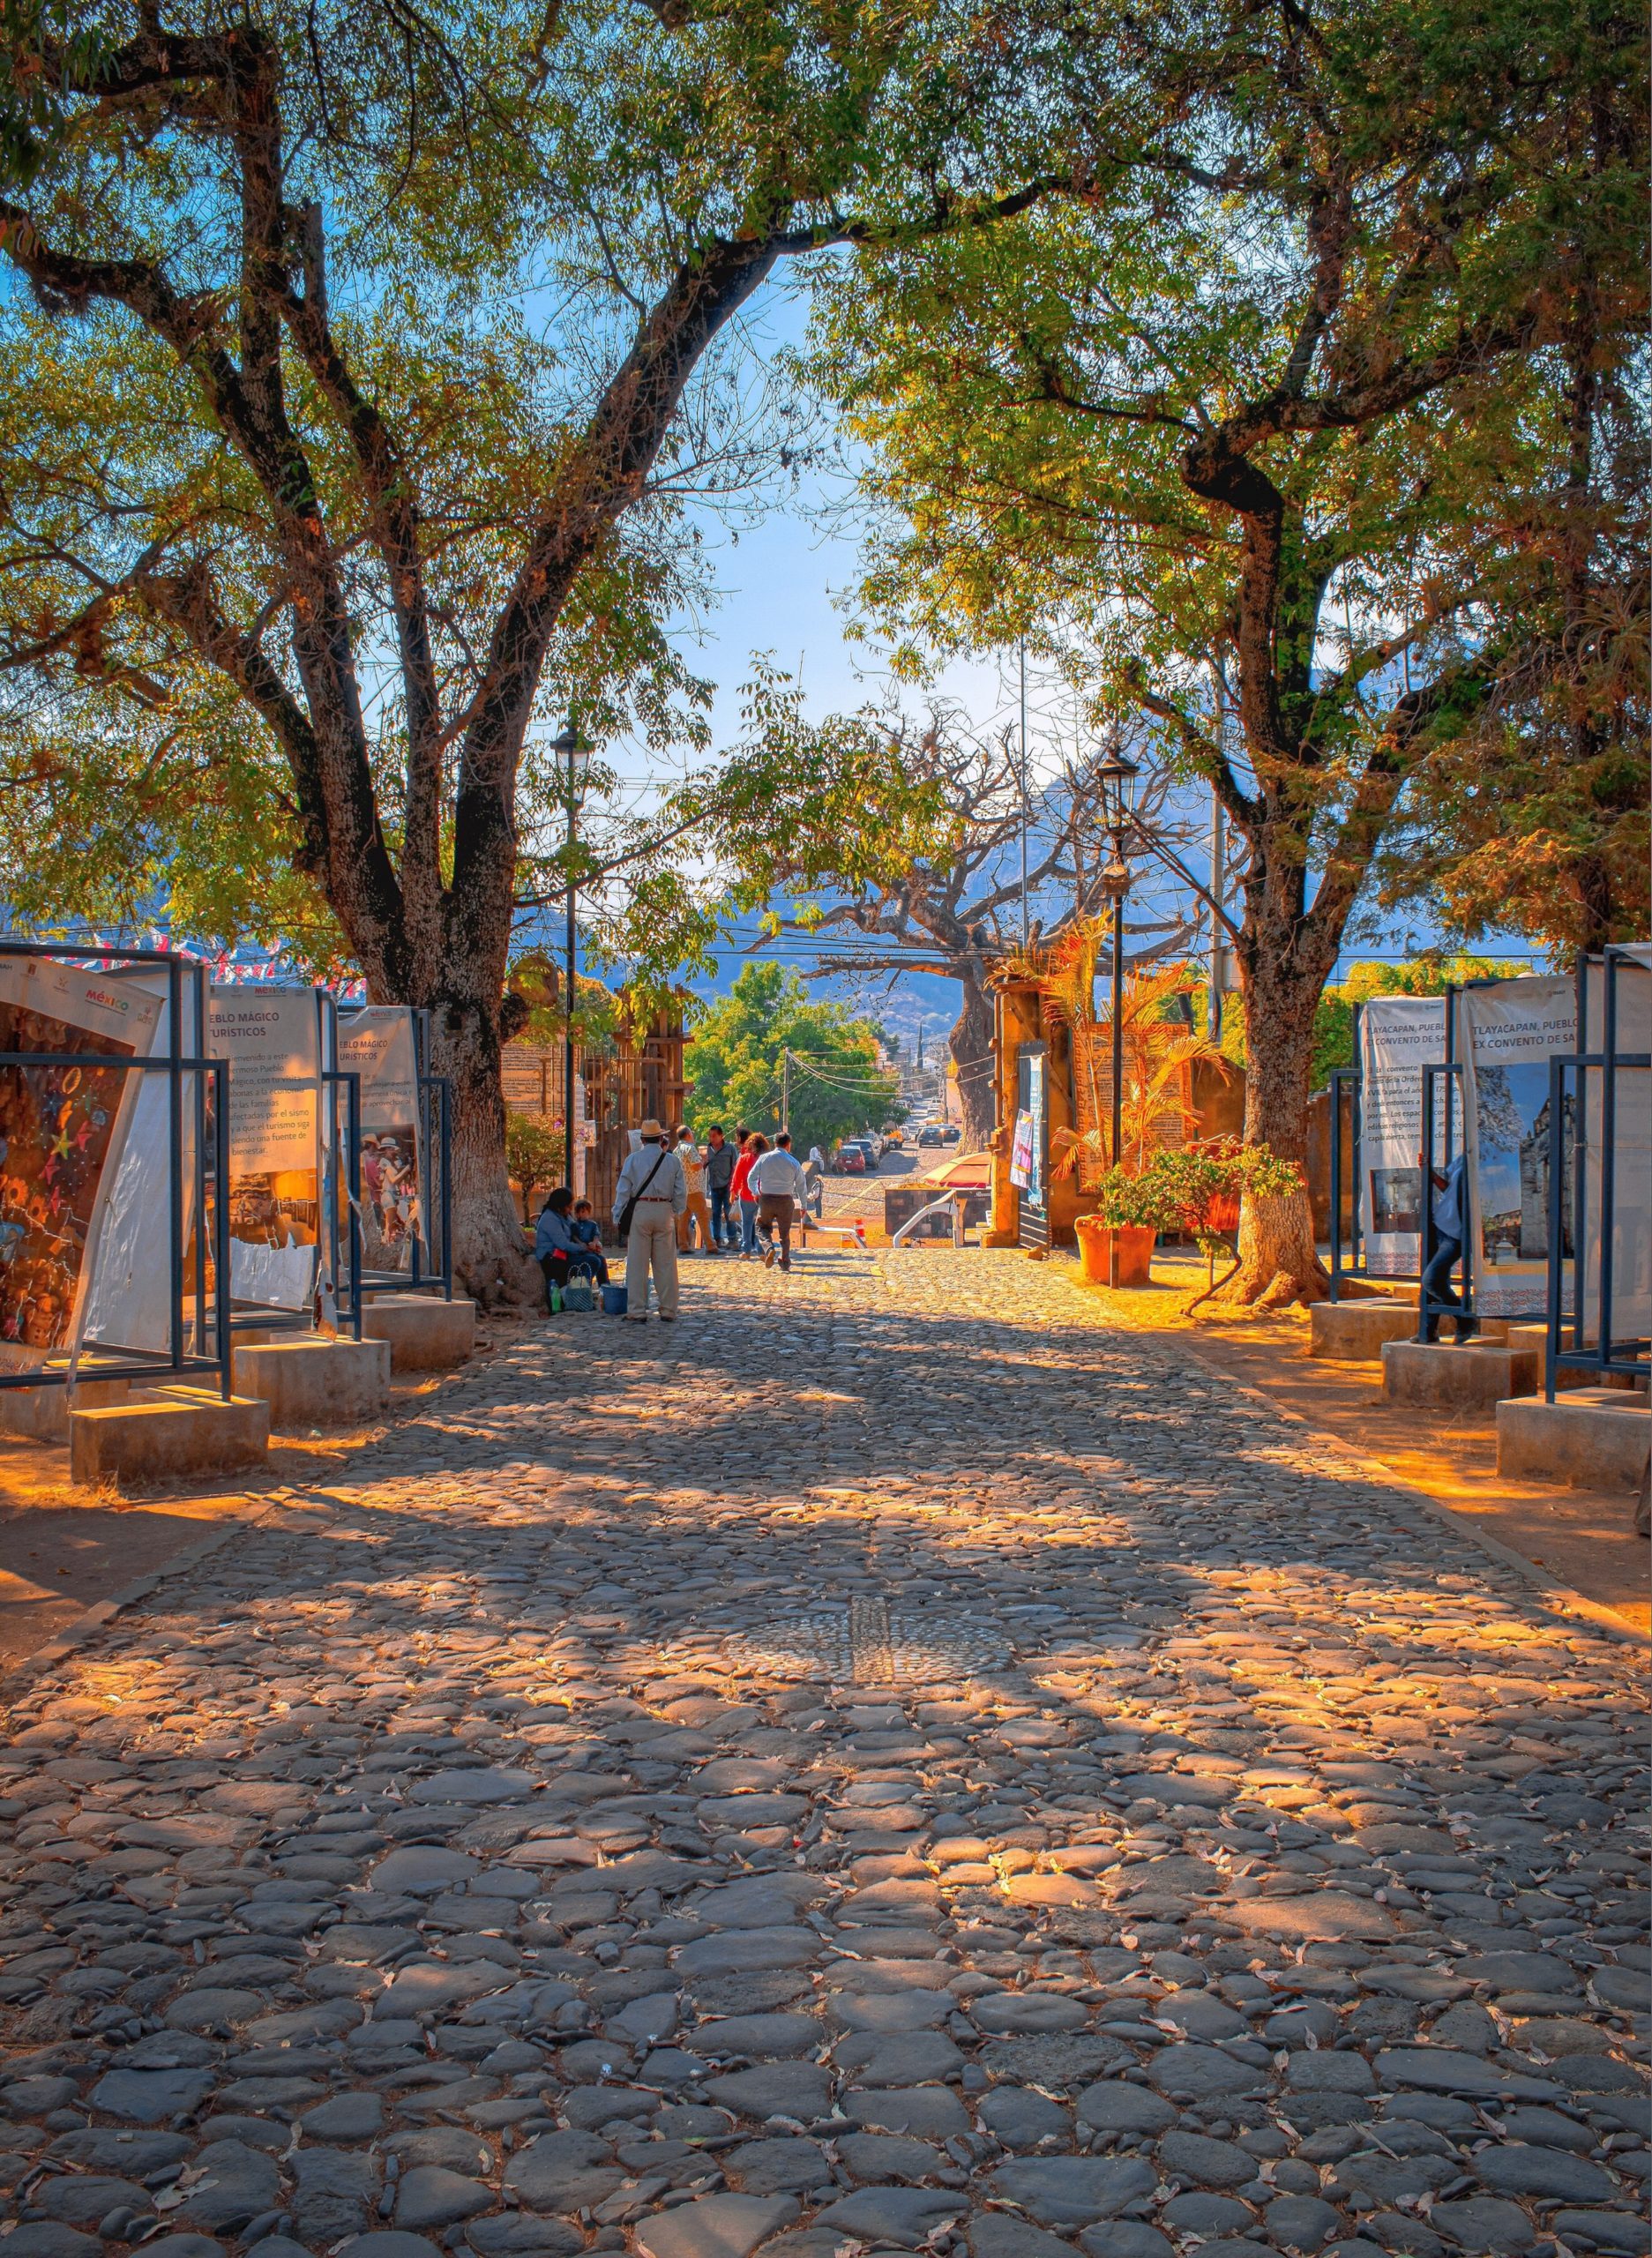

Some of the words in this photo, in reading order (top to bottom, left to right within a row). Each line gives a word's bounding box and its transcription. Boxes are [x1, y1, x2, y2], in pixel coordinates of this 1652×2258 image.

[238, 1011, 280, 1022] MÁGICO
[1472, 1023, 1541, 1036] TLAYACAPAN,
[360, 1038, 388, 1048] MÁGICO
[1375, 1036, 1420, 1046] CONVENTO
[1422, 1035, 1433, 1043] DE
[1473, 1040, 1485, 1050] EX
[1487, 1036, 1544, 1050] CONVENTO
[1547, 1035, 1560, 1044] DE
[1563, 1033, 1575, 1043] SA
[259, 1065, 285, 1073] Pueblo
[250, 1099, 280, 1108] familias
[229, 1111, 265, 1121] afectadas
[280, 1109, 288, 1118] el
[289, 1108, 310, 1117] sismo
[243, 1124, 256, 1133] que
[258, 1123, 265, 1132] el
[265, 1120, 295, 1130] turismo
[297, 1119, 310, 1130] siga
[1388, 1121, 1419, 1131] religiosos
[231, 1134, 255, 1145] siendo
[272, 1132, 296, 1141] fuente
[298, 1130, 307, 1140] de
